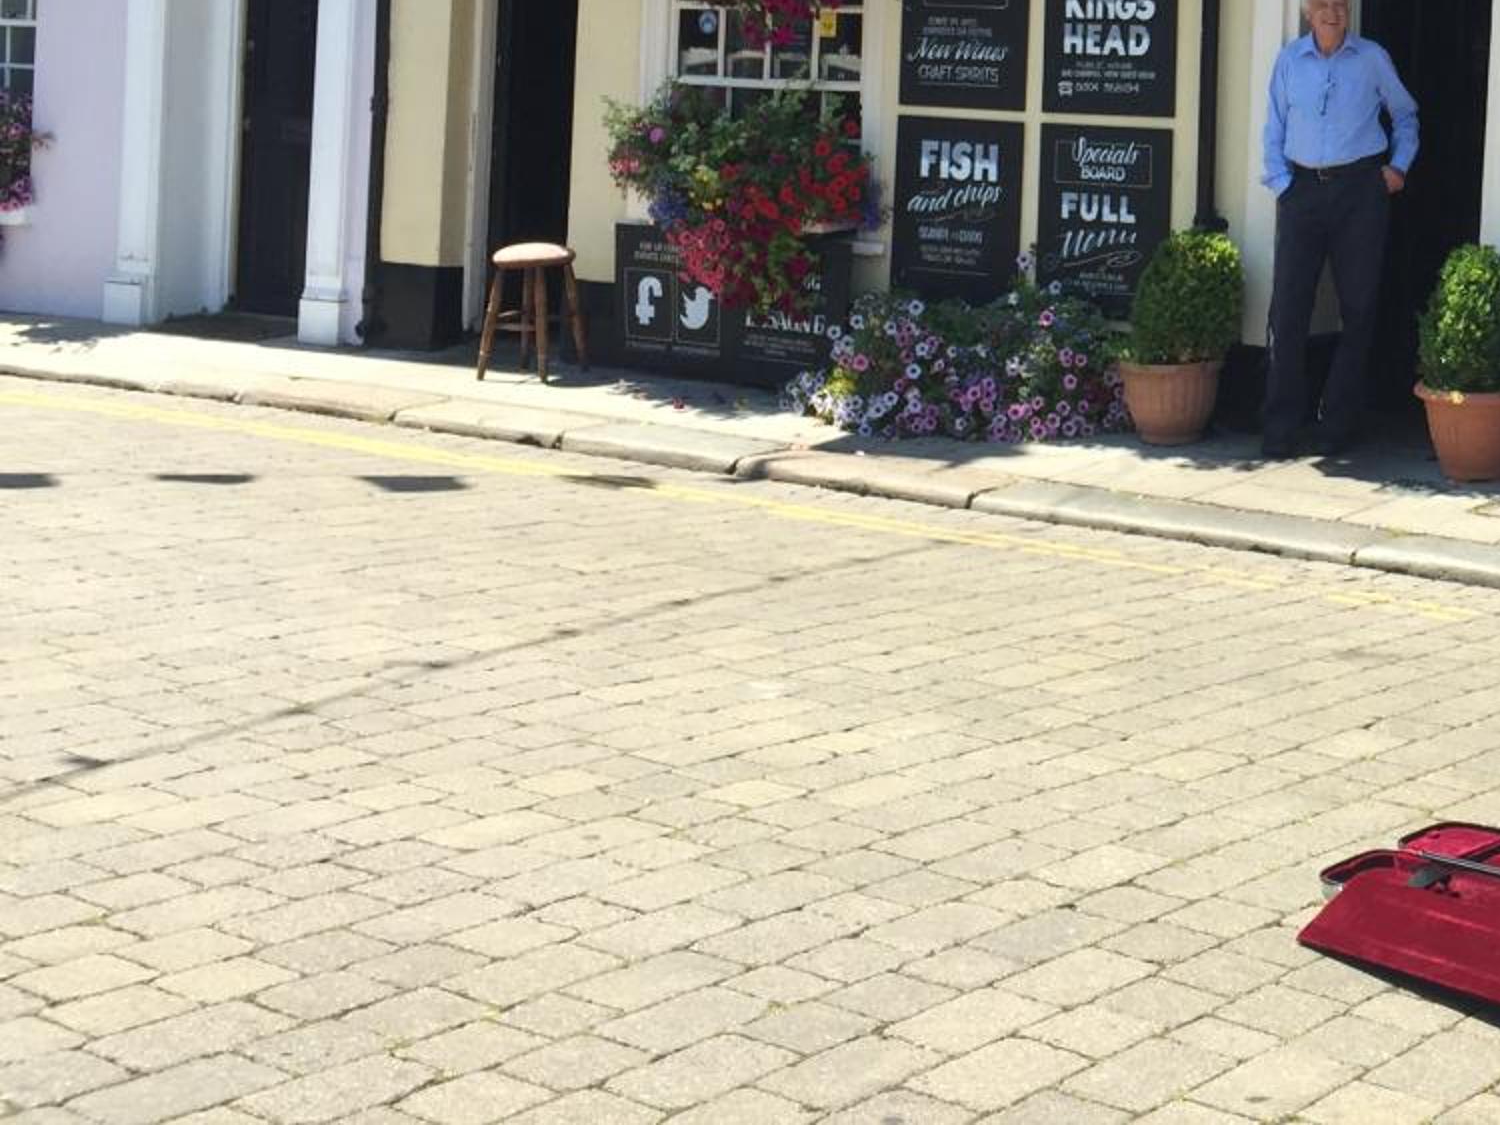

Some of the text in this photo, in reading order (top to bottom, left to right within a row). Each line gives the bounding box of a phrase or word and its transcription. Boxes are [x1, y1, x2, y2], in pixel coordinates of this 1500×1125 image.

[1063, 23, 1151, 57] HEAD
[919, 138, 999, 183] FISH
[1071, 136, 1140, 168] Specials
[1079, 166, 1128, 182] BOARD
[906, 183, 1002, 214] and chips
[1060, 191, 1138, 224] FULL
